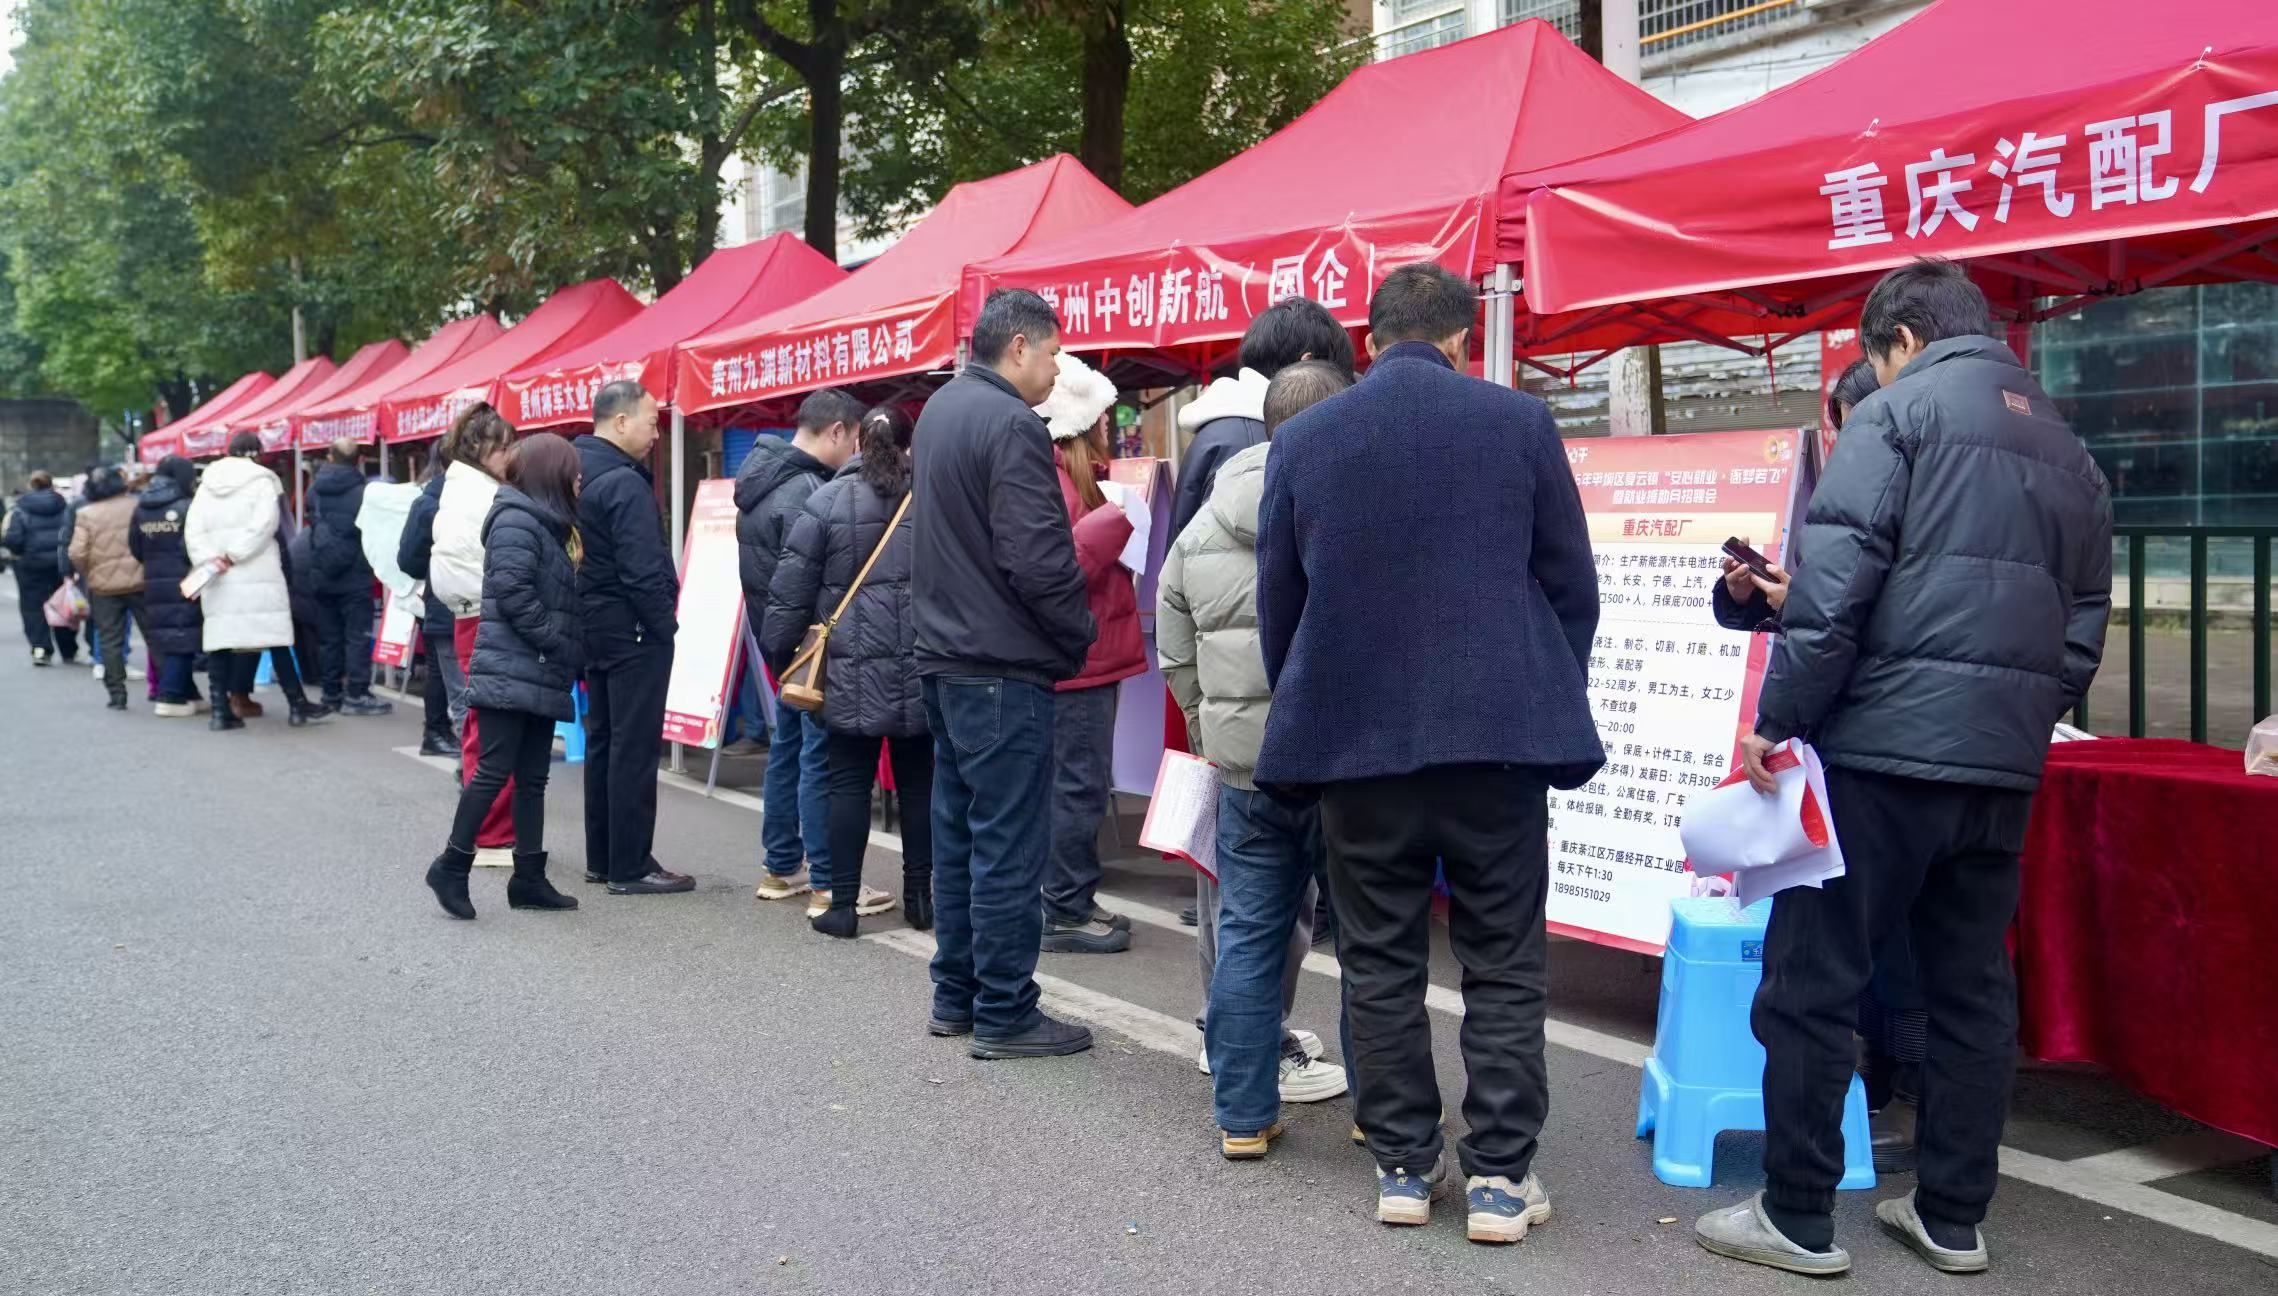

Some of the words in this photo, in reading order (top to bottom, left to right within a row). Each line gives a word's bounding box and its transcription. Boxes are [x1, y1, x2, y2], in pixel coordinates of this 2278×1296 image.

[1819, 90, 2278, 250] 重庆汽配厂
[1622, 518, 1693, 537] 重庆汽配厂
[1554, 881, 1611, 903] 18985151029
